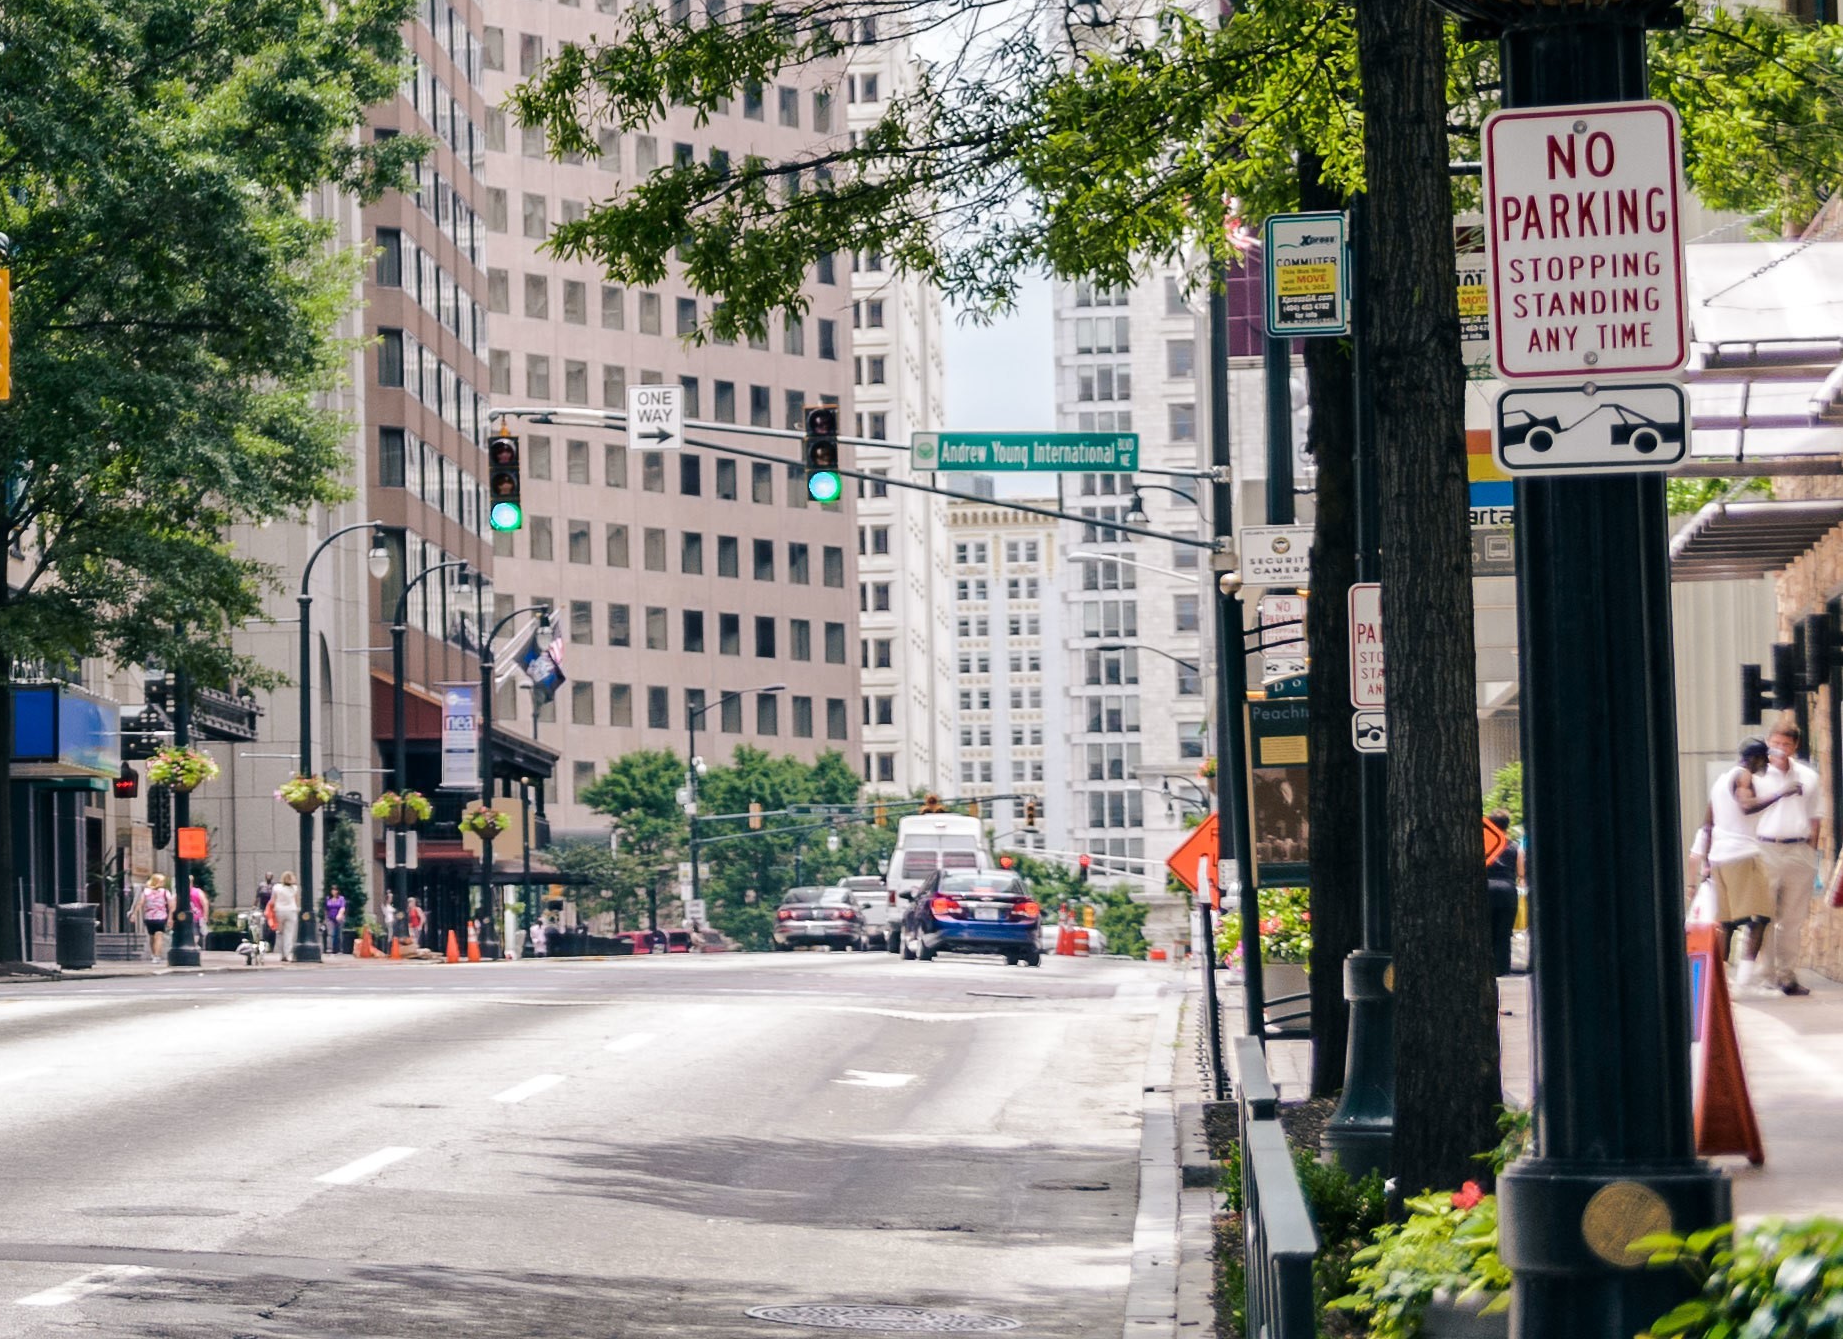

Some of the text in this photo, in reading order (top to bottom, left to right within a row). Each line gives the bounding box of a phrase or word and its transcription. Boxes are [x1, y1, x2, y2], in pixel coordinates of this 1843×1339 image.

[1546, 131, 1615, 180] NO
[1501, 187, 1667, 242] PARKING
[1276, 256, 1338, 267] COMMUTER
[1509, 251, 1661, 284] STOPPING
[1296, 274, 1327, 284] MOVE
[1513, 286, 1660, 319] STANDING
[1528, 322, 1653, 353] ANY TIME
[637, 390, 673, 406] ONE
[637, 408, 673, 423] WAY
[940, 440, 1115, 470] Andrew Young International
[1120, 453, 1132, 467] NE
[1275, 601, 1292, 613] NO
